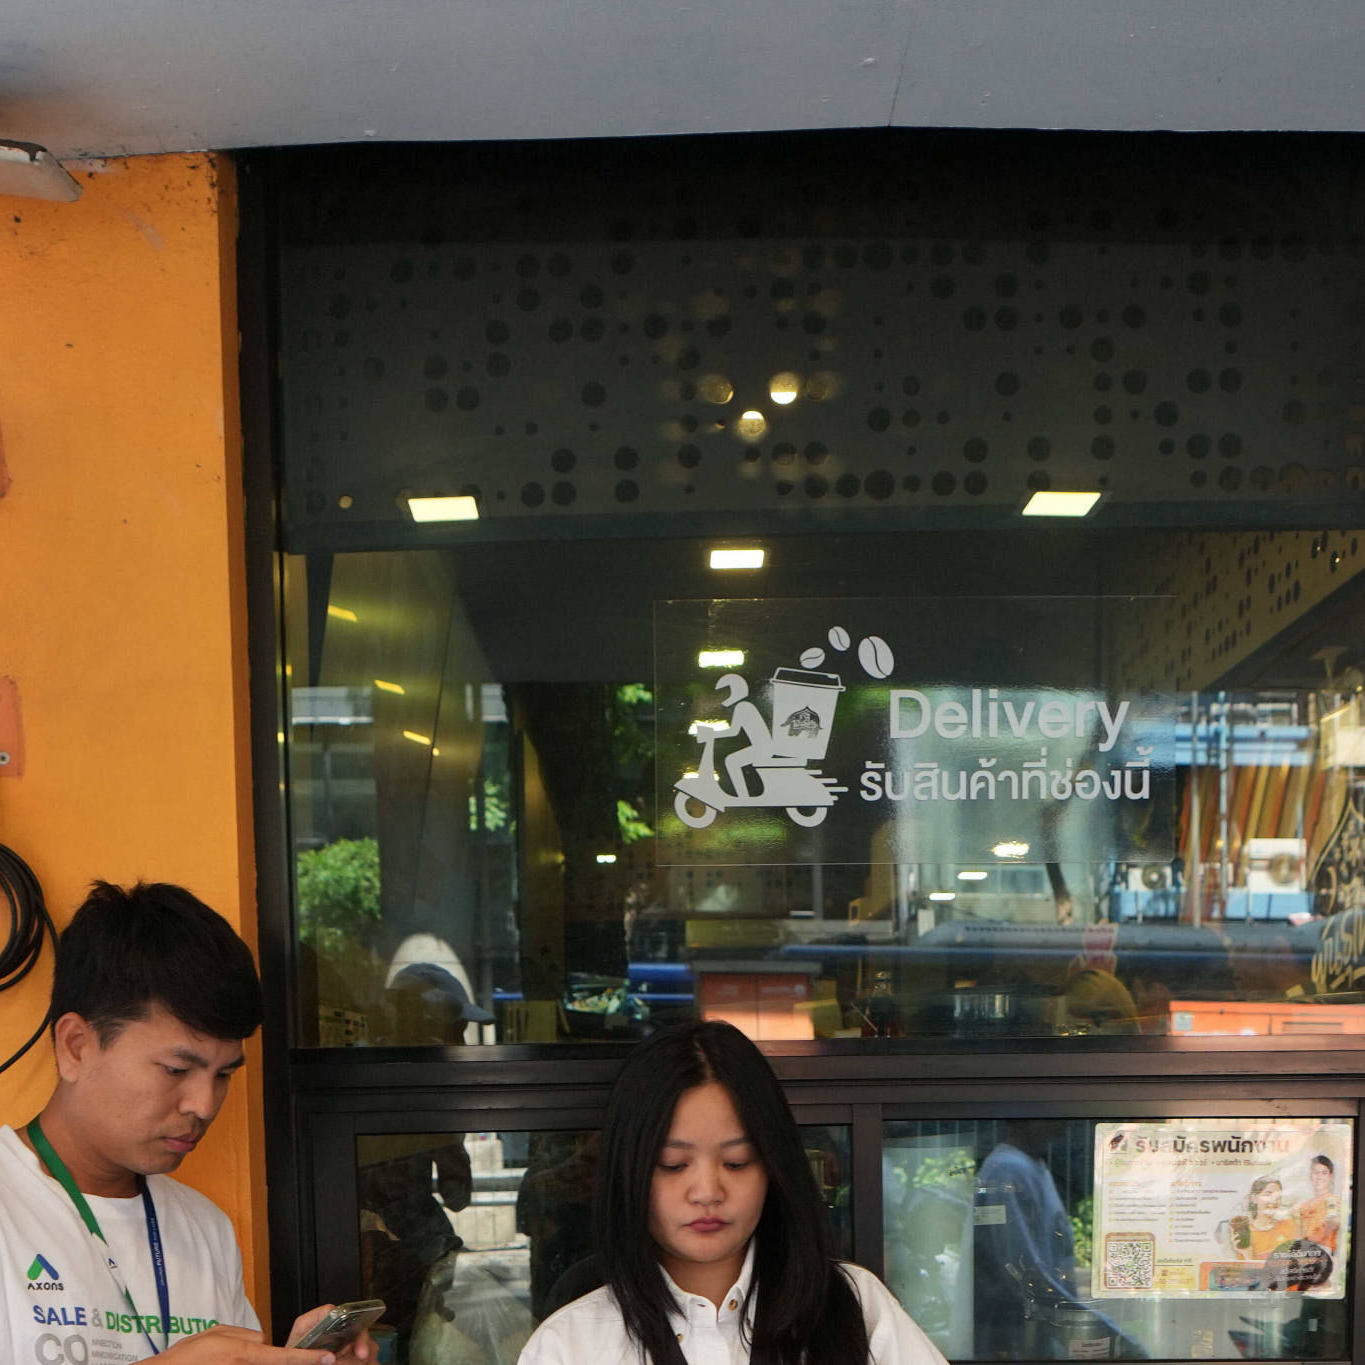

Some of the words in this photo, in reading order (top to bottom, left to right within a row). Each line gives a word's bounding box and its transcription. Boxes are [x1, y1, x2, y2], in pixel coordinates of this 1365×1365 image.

[889, 688, 1131, 752] Delivery
[860, 746, 1154, 801] รับสินค้าที่ช่องนี้
[32, 1305, 88, 1327] SALE
[91, 1308, 104, 1329] &
